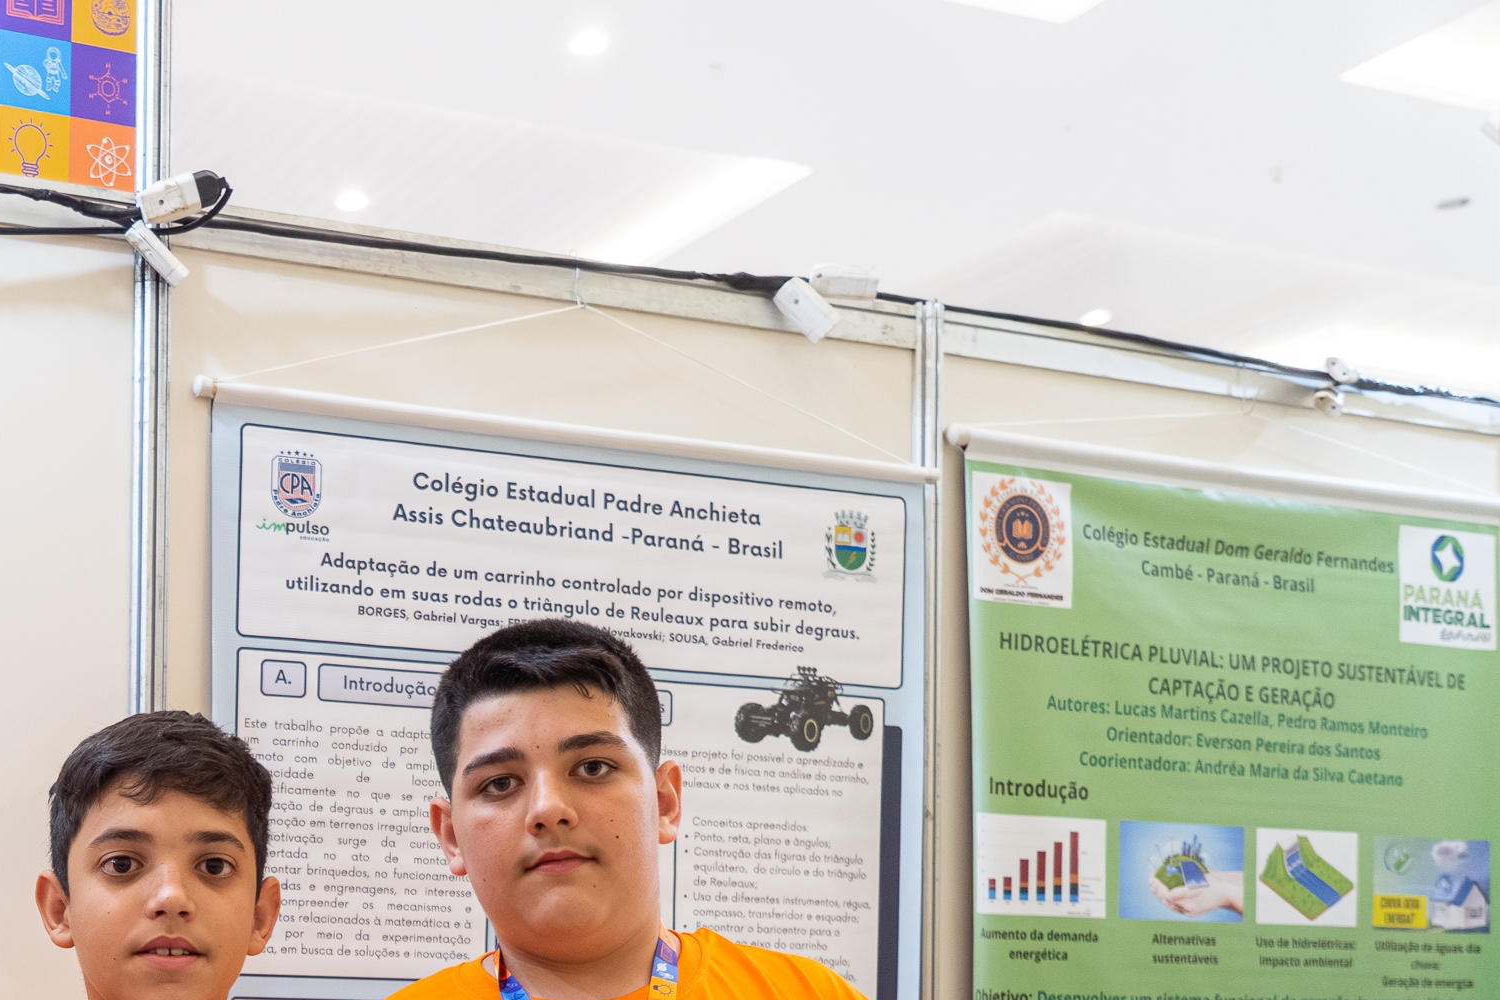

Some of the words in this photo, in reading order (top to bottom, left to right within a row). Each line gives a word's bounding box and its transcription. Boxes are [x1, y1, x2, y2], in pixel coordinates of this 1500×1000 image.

[280, 473, 313, 497] CPA
[413, 472, 498, 501] Colégio
[506, 482, 594, 507] Estadual
[604, 493, 662, 515] Padre
[669, 501, 760, 525] Anchieta
[256, 518, 330, 536] impulso
[392, 504, 443, 524] Assis
[451, 509, 612, 541] Chateaubriand
[622, 528, 704, 551] -Paraná
[728, 538, 782, 558] Brasil
[1082, 524, 1138, 548] Colégio
[1143, 530, 1211, 553] Estadual
[1214, 539, 1251, 557] Dom
[1253, 544, 1313, 564] Geraldo
[1316, 551, 1394, 573] Fernandes
[320, 552, 420, 576] Adaptação
[426, 561, 447, 577] de
[454, 569, 478, 580] um
[484, 571, 555, 587] carrinho
[562, 578, 651, 596] controlado
[657, 588, 683, 602] por
[688, 586, 773, 607] dispositivo
[779, 599, 836, 615] remoto,
[1141, 560, 1193, 580] Cambé
[1206, 568, 1259, 587] Paraná
[1273, 575, 1315, 592] Brasil
[286, 575, 373, 596] utilizando
[380, 588, 405, 599] em
[412, 591, 448, 603] suas
[454, 590, 502, 607] rodas
[508, 599, 517, 608] o
[523, 597, 599, 618] triângulo
[605, 602, 624, 618] de
[631, 606, 703, 625] Reuleaux
[710, 618, 748, 631] para
[754, 617, 790, 632] subir
[795, 620, 859, 640] degraus.
[1404, 584, 1483, 610] PARANÁ
[358, 605, 408, 620] BORGES,
[413, 610, 456, 622] Gabriel
[460, 614, 504, 630] Vargas;
[1404, 605, 1491, 629] INTEGRAL
[603, 626, 665, 642] Novakovski;
[669, 633, 708, 645] SOUSA,
[712, 636, 752, 647] Gabriel
[756, 639, 804, 652] Frederico
[1000, 631, 1142, 661] HIDROELÉTRICA
[1148, 645, 1223, 668] PLUVIAL:
[1229, 654, 1256, 671] UM
[1261, 656, 1332, 679] PROJETO
[1337, 663, 1442, 687] SUSTENTÁVEL
[1447, 673, 1465, 690] DE
[274, 669, 292, 685] A.
[343, 675, 437, 699] Introdução
[1148, 677, 1239, 703] CAPTAÇÃO
[1245, 685, 1253, 702] E
[1258, 687, 1335, 711] GERAÇÃO
[1046, 695, 1110, 714] Autores:
[1114, 700, 1156, 717] Lucas
[1160, 704, 1216, 722] Martins
[1220, 709, 1272, 728] Cazella,
[1277, 713, 1316, 729] Pedro
[1320, 717, 1364, 734] Ramos
[1368, 721, 1428, 738] Monteiro
[1106, 727, 1192, 746] Orientador:
[1196, 733, 1252, 750] Everson
[1255, 737, 1305, 754] Pereira
[1308, 742, 1332, 757] dos
[1334, 743, 1380, 760] Santos
[1079, 751, 1190, 772] Coorientadora:
[1194, 759, 1245, 776] Andréa
[1249, 763, 1289, 779] Maria
[1292, 765, 1308, 780] da
[1312, 767, 1344, 782] Silva
[1348, 769, 1403, 786] Caetano
[990, 778, 1088, 803] Introdução
[692, 816, 743, 828] Conceitos
[746, 820, 808, 831] apreendidos:
[694, 831, 725, 843] Ponto,
[728, 834, 751, 844] reta,
[754, 834, 781, 846] plano
[784, 838, 790, 846] e
[793, 837, 830, 850] ângulos;
[323, 885, 396, 897] engrenagens,
[425, 887, 472, 898] interesse
[298, 912, 370, 925] relacionados
[374, 916, 381, 925] à
[384, 918, 450, 928] matemática
[464, 919, 471, 929] à
[981, 929, 1027, 940] Aumento
[1030, 929, 1044, 941] da
[1046, 930, 1098, 942] demanda
[1152, 934, 1216, 946] Alternativas
[280, 946, 296, 954] em
[301, 943, 333, 955] busca
[336, 944, 351, 956] de
[354, 945, 400, 959] soluções
[414, 950, 470, 961] inovações.
[1009, 949, 1068, 963] energética
